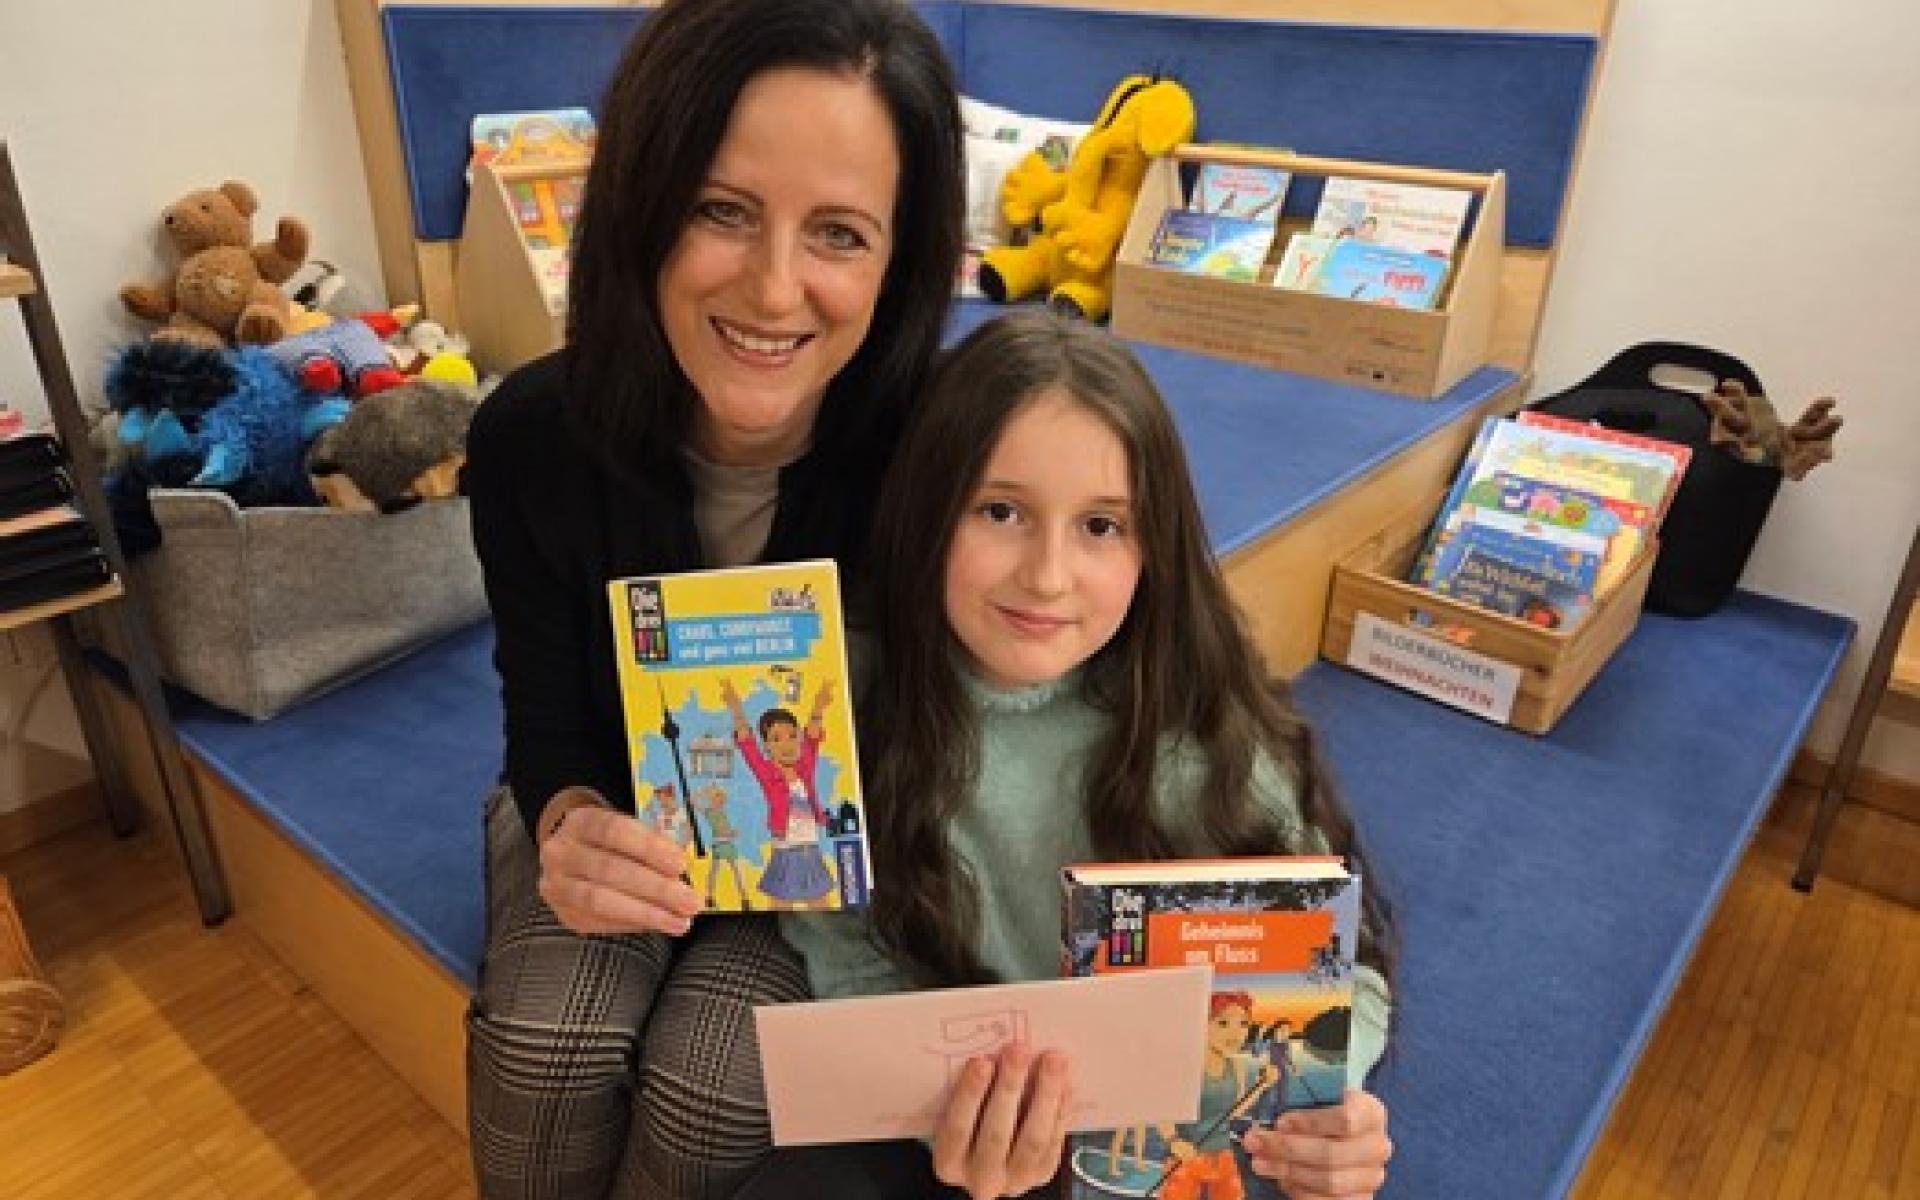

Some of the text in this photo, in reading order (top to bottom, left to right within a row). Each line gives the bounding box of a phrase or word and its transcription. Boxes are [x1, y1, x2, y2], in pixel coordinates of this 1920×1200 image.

[1368, 652, 1496, 710] WEIHNACHTEN
[1181, 919, 1264, 941] Geheimnis
[1214, 943, 1259, 963] Fluss
